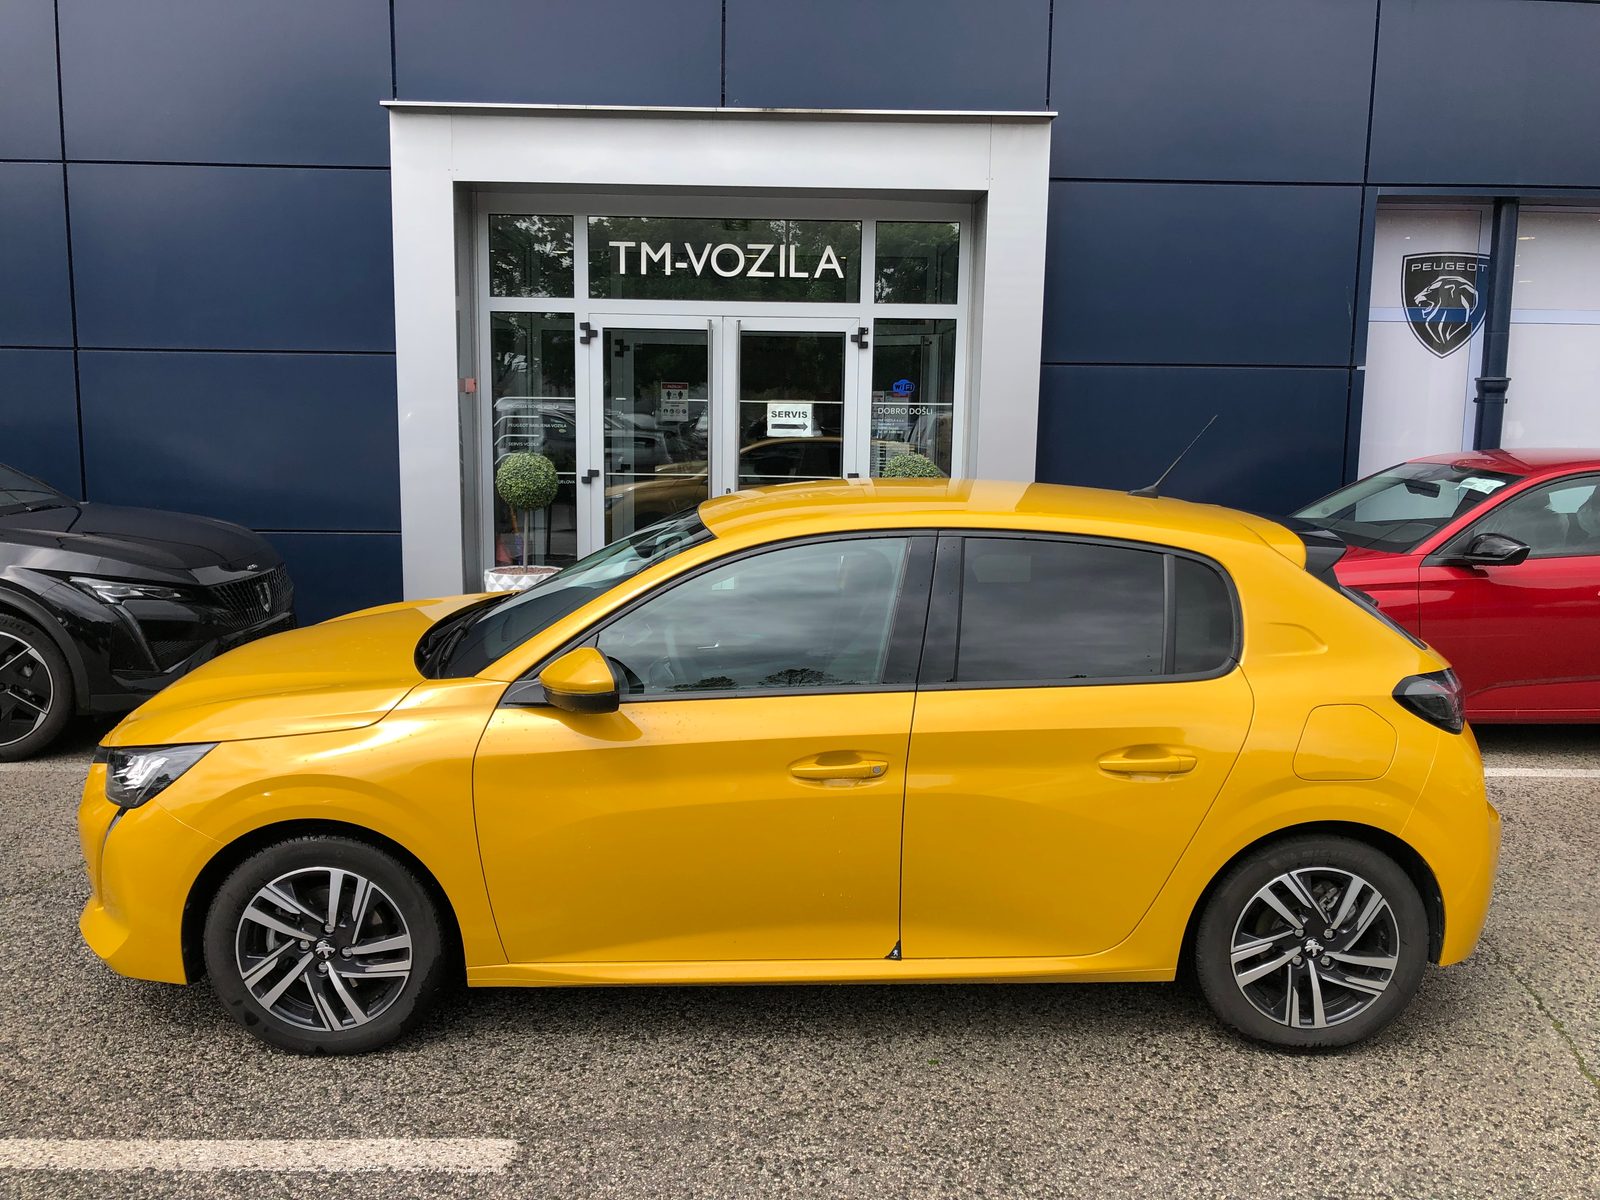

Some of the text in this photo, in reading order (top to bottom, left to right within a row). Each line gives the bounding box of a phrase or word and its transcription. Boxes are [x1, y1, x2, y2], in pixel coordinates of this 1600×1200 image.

[608, 241, 845, 279] TM-VOZILA
[1411, 262, 1488, 273] PEUGEOT
[771, 410, 808, 419] SERVIS
[877, 406, 933, 415] DOBRO DOŠLI
